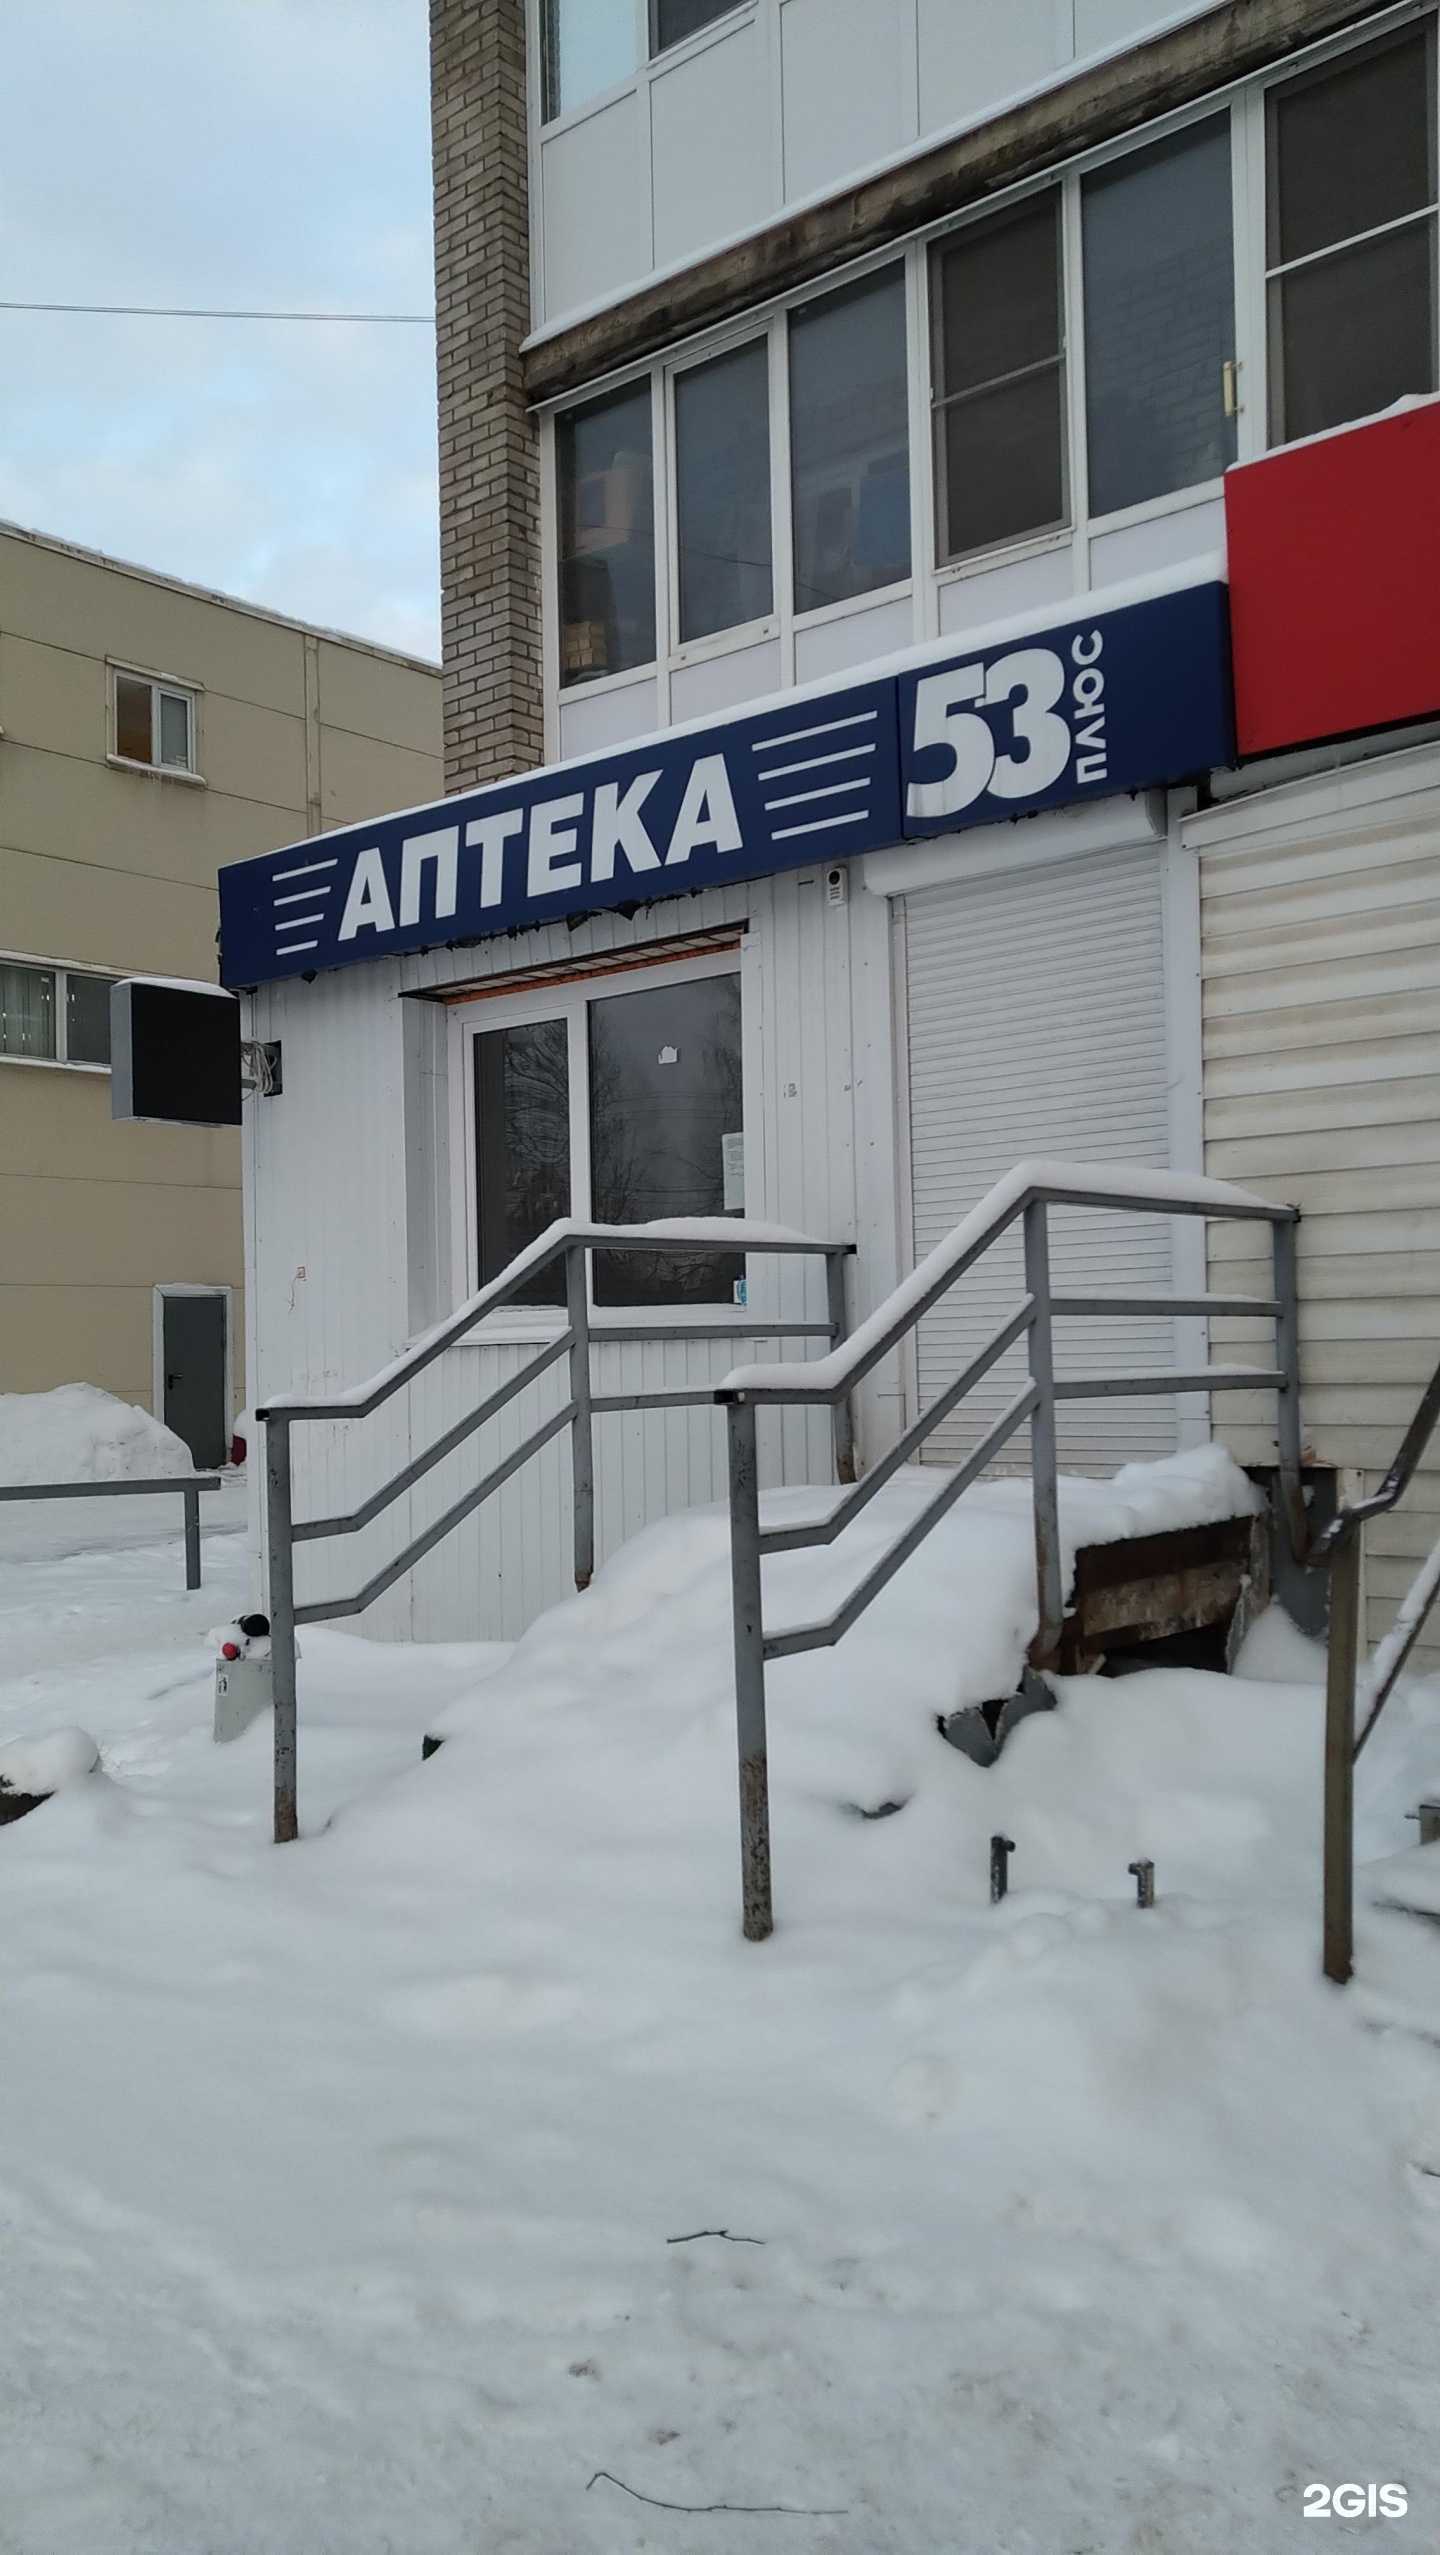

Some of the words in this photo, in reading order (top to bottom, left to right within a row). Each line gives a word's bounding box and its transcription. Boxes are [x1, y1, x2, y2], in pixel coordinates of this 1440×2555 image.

[337, 752, 744, 942] АПТЕКА
[906, 647, 1072, 819] 53
[1071, 629, 1108, 785] ПЛЮС
